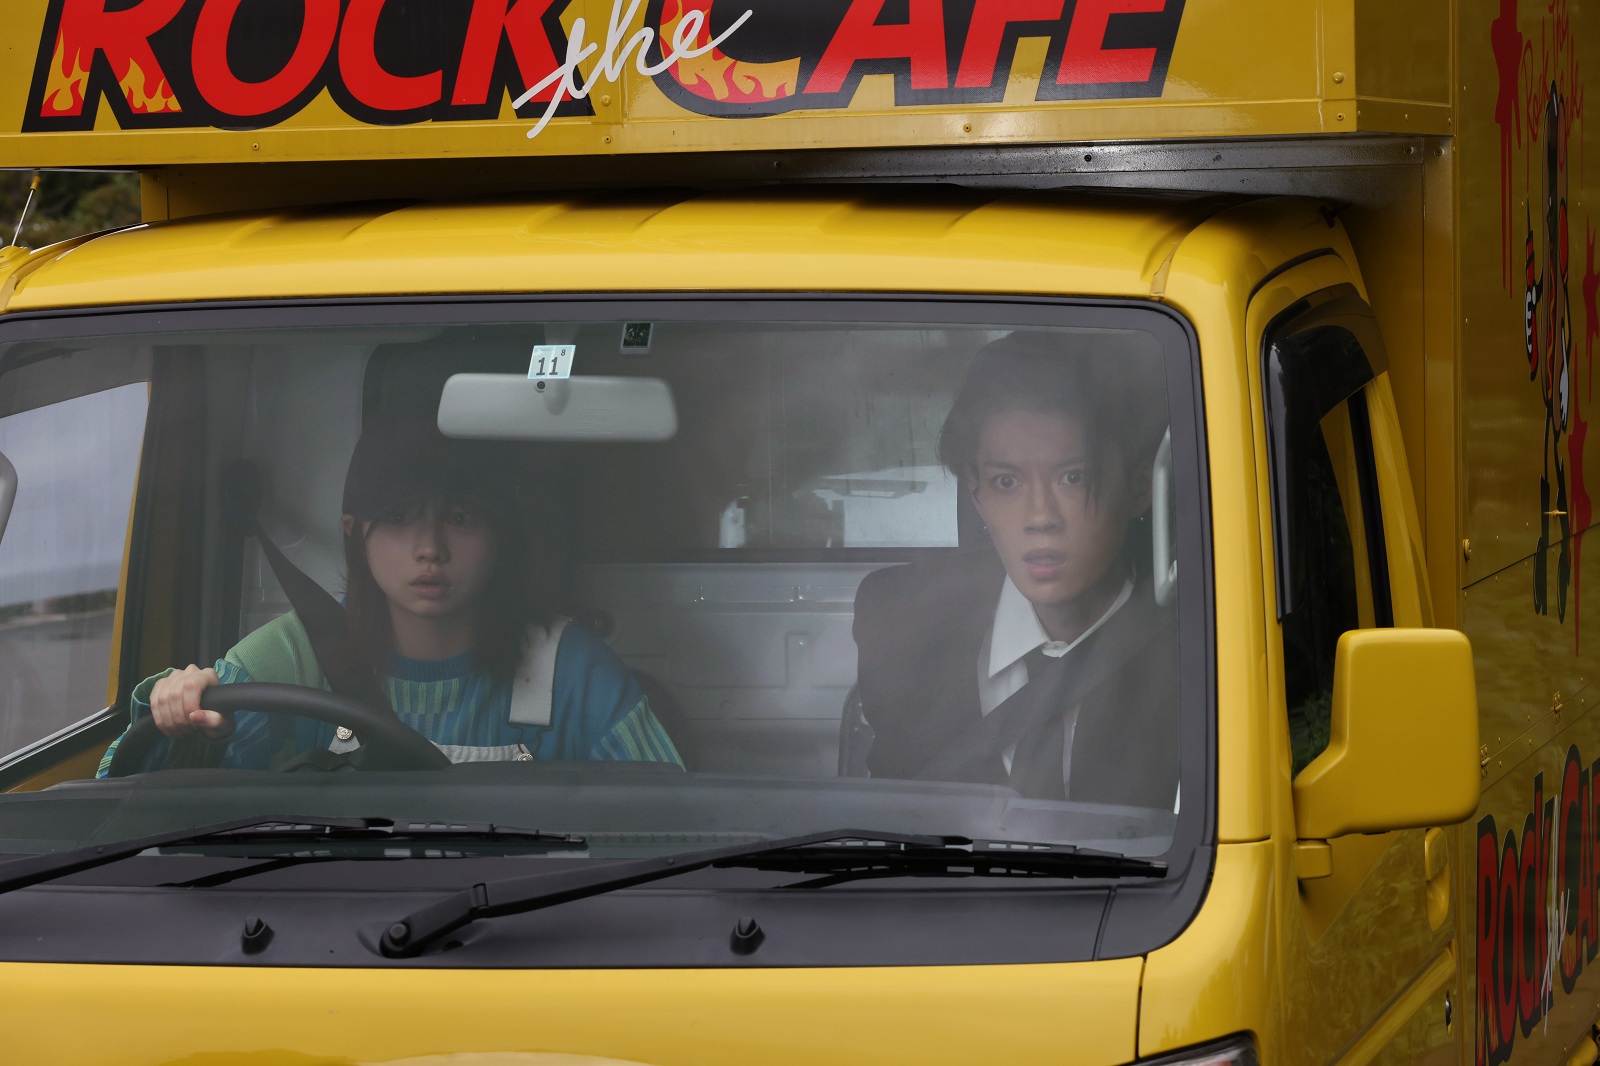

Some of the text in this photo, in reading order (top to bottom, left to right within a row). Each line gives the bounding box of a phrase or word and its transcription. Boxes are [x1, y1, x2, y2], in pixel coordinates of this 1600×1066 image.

[512, 0, 752, 138] the
[560, 348, 566, 356] 8
[535, 356, 558, 376] 11
